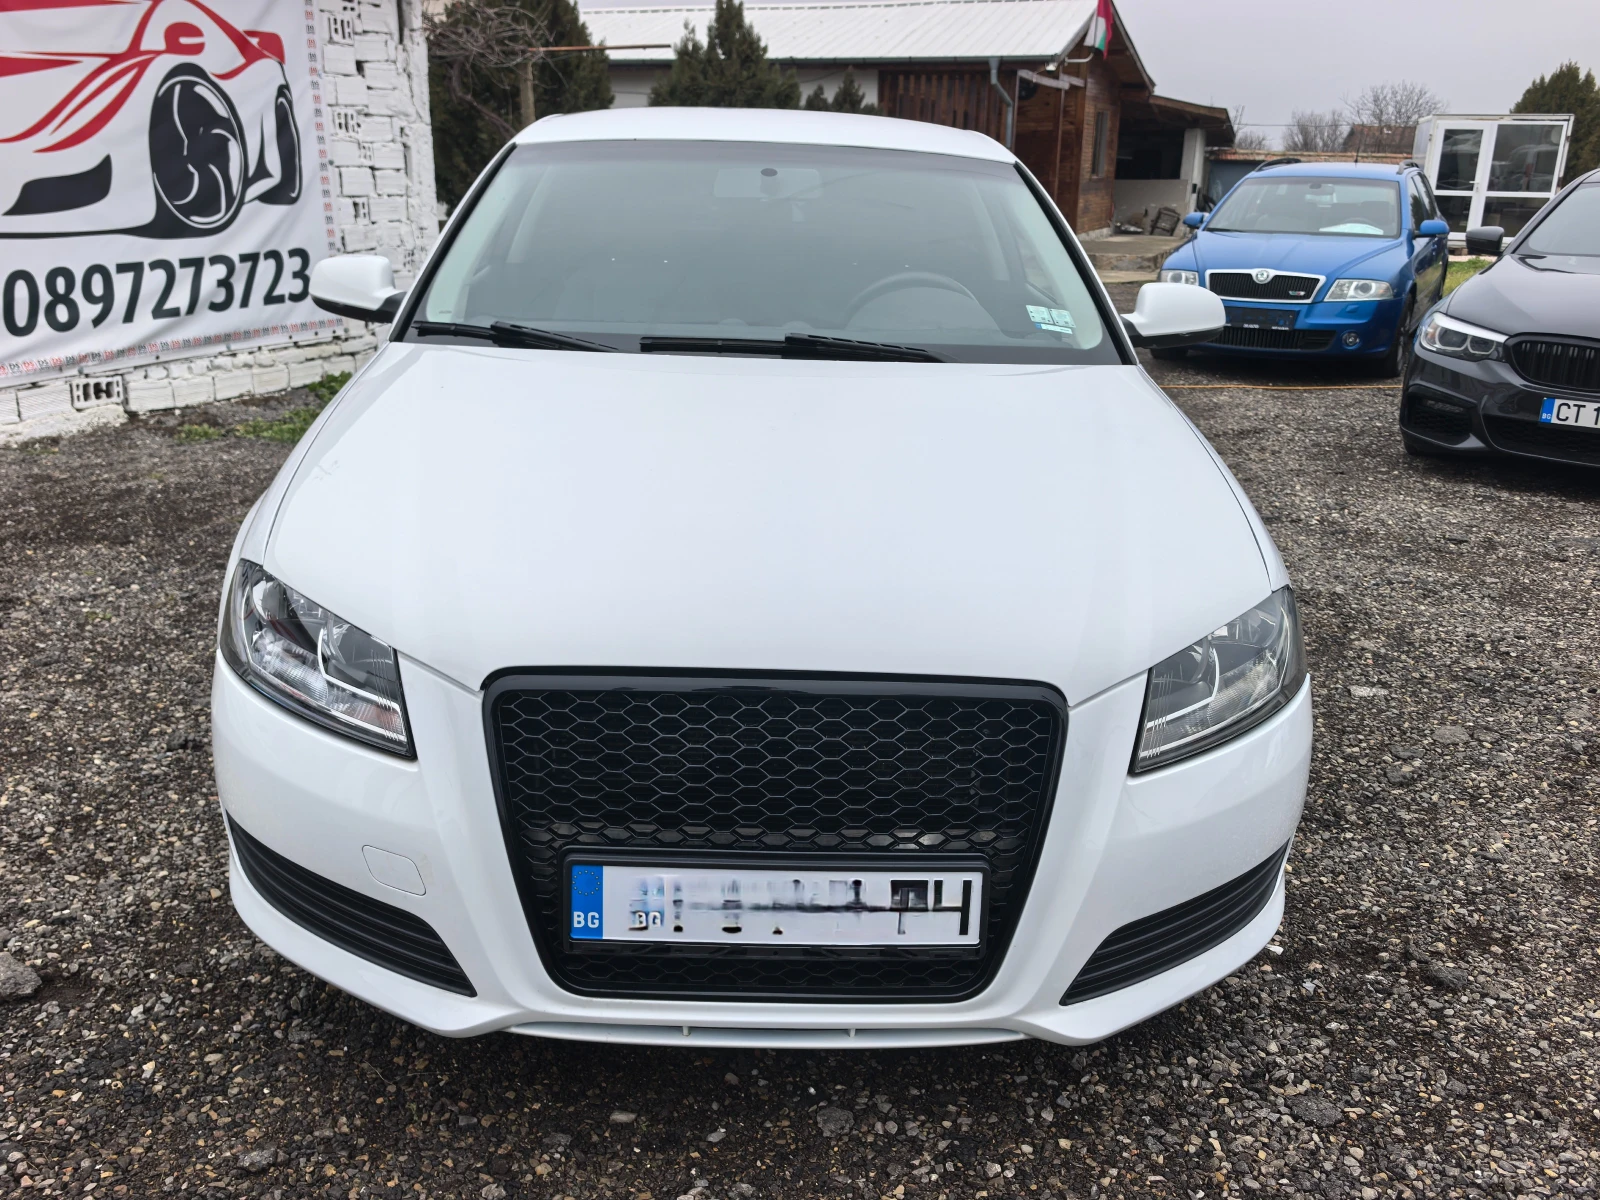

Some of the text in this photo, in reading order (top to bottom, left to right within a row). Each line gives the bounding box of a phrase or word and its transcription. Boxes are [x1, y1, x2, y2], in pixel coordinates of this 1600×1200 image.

[3, 248, 310, 337] 0897273723
[1556, 402, 1587, 424] CT
[573, 911, 600, 928] BG
